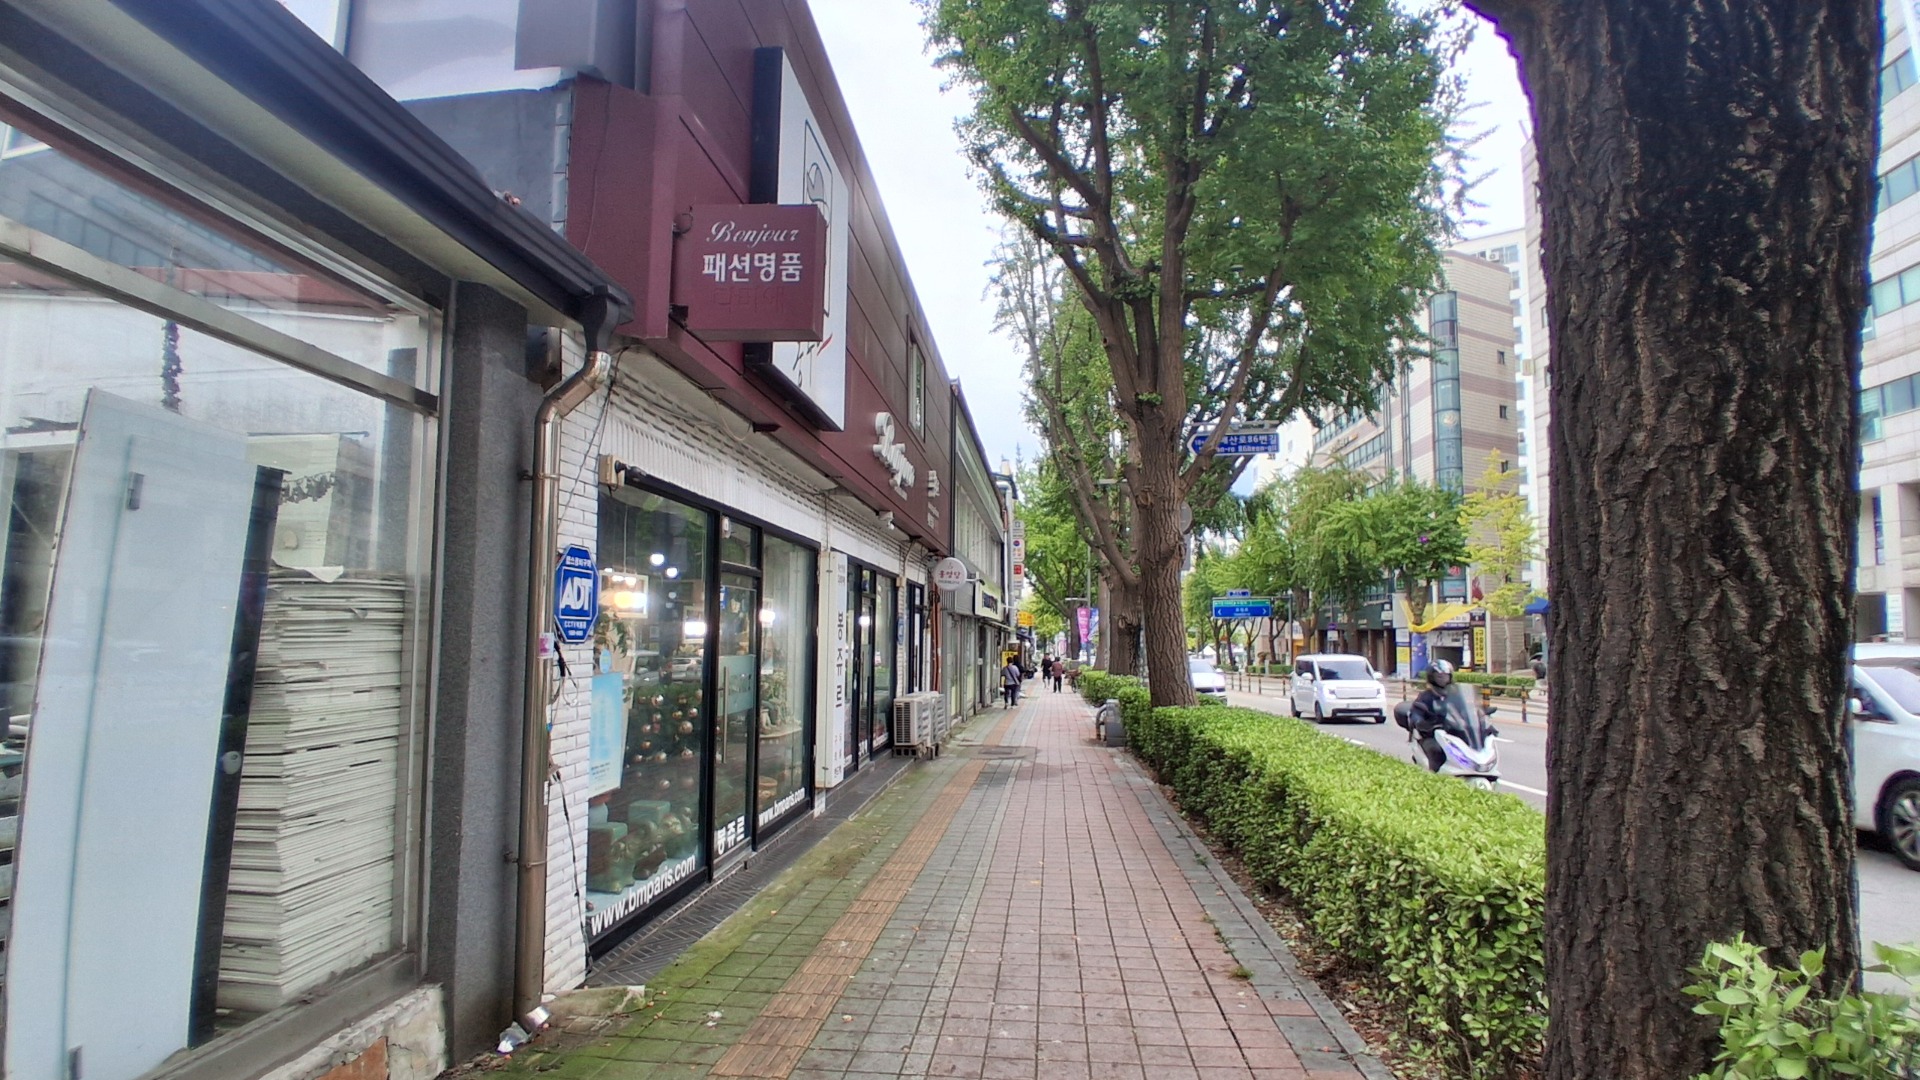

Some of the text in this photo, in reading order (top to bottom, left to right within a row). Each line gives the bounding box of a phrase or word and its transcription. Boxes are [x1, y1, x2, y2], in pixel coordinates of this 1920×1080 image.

[706, 220, 799, 248] Bonjour
[702, 252, 803, 282] 패션명품
[560, 576, 592, 611] ADT
[759, 787, 805, 827] www.bmparis.com
[717, 815, 745, 856] 봉쥬르
[591, 855, 695, 936] www.bmparis.com
